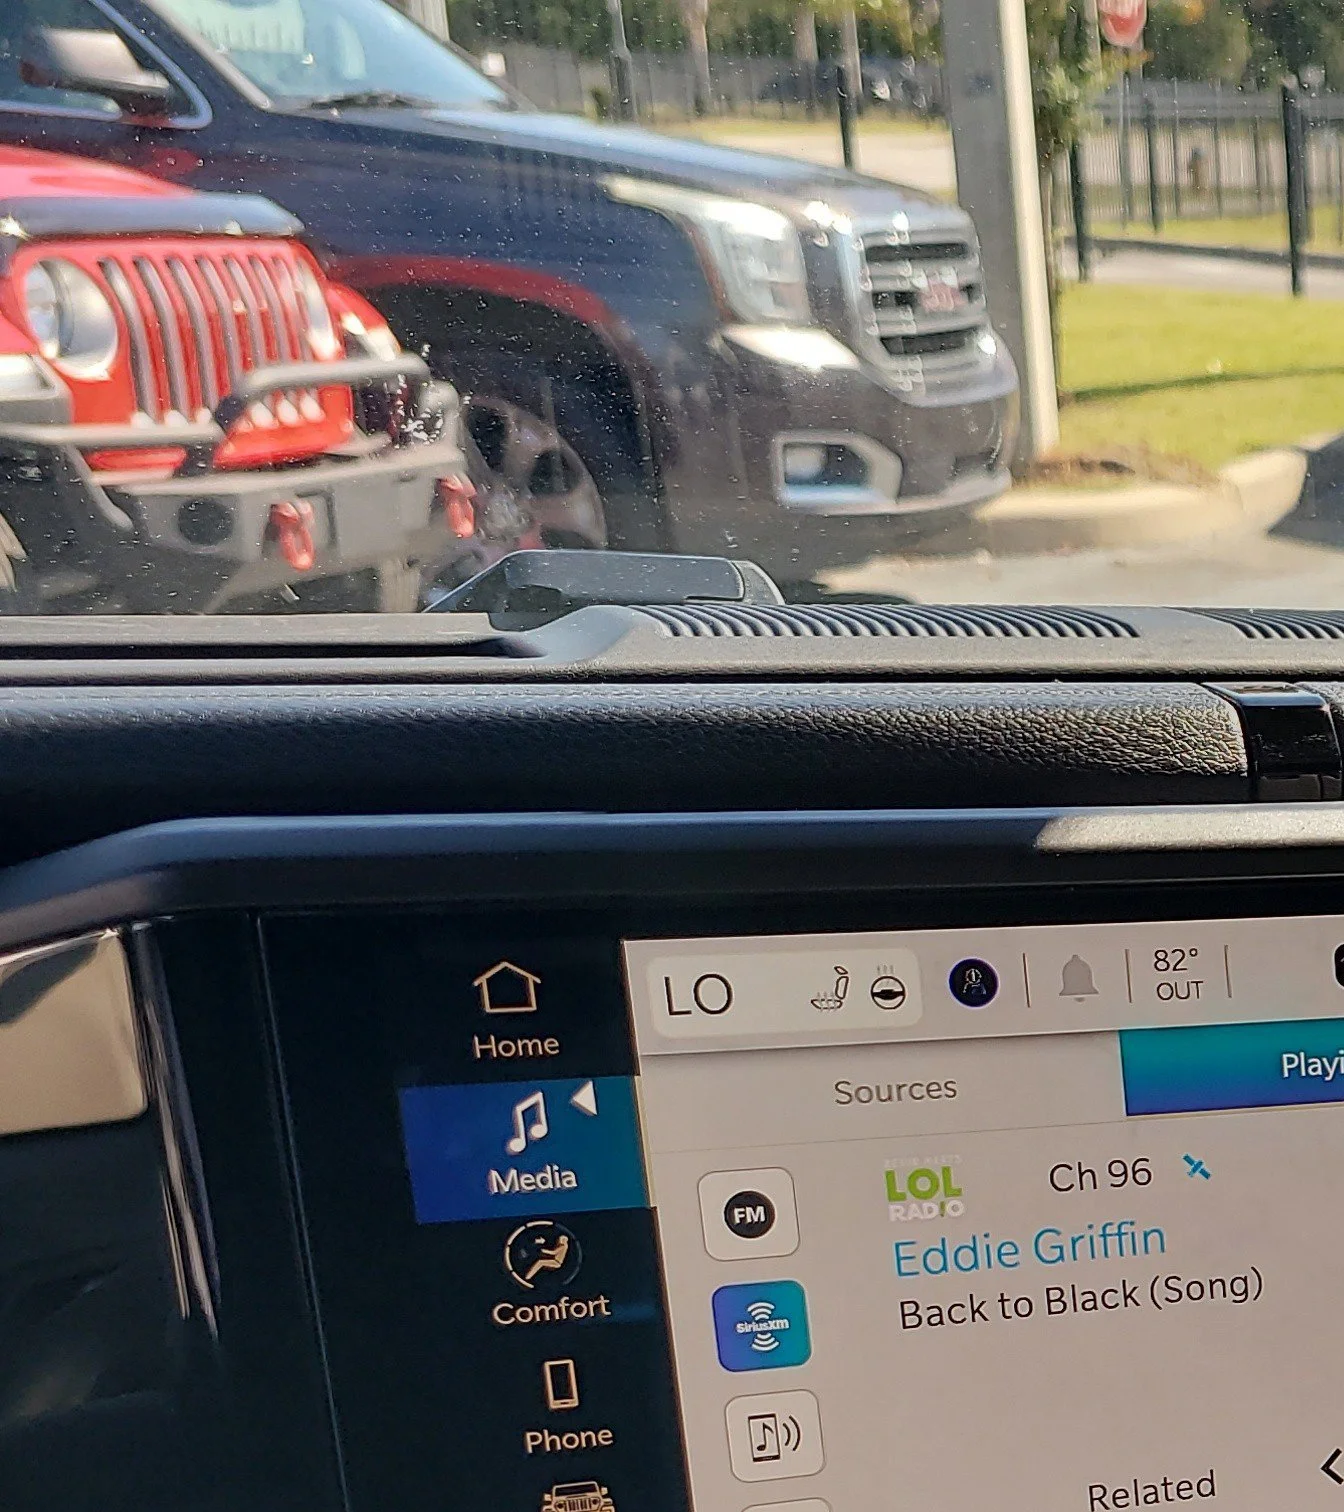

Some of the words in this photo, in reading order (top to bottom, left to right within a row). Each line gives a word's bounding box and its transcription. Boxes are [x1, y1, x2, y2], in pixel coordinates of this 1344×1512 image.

[1154, 947, 1199, 973] 82°
[663, 972, 734, 1016] LO
[1156, 981, 1203, 1001] OUT
[473, 1033, 560, 1059] Home
[834, 1078, 958, 1106] Sources
[490, 1165, 578, 1193] Media
[884, 1165, 963, 1203] LOL
[1049, 1163, 1098, 1193] Ch
[1107, 1158, 1153, 1188] 96
[734, 1206, 765, 1225] FM
[893, 1232, 1020, 1277] Eddie
[1033, 1220, 1166, 1266] Griffin
[492, 1293, 611, 1326] Comfort
[899, 1293, 990, 1331] Back
[998, 1290, 1034, 1321] to
[1046, 1277, 1141, 1316] Black
[1150, 1266, 1264, 1312] (Song)
[525, 1425, 614, 1454] Phone
[1088, 1468, 1217, 1512] Related
